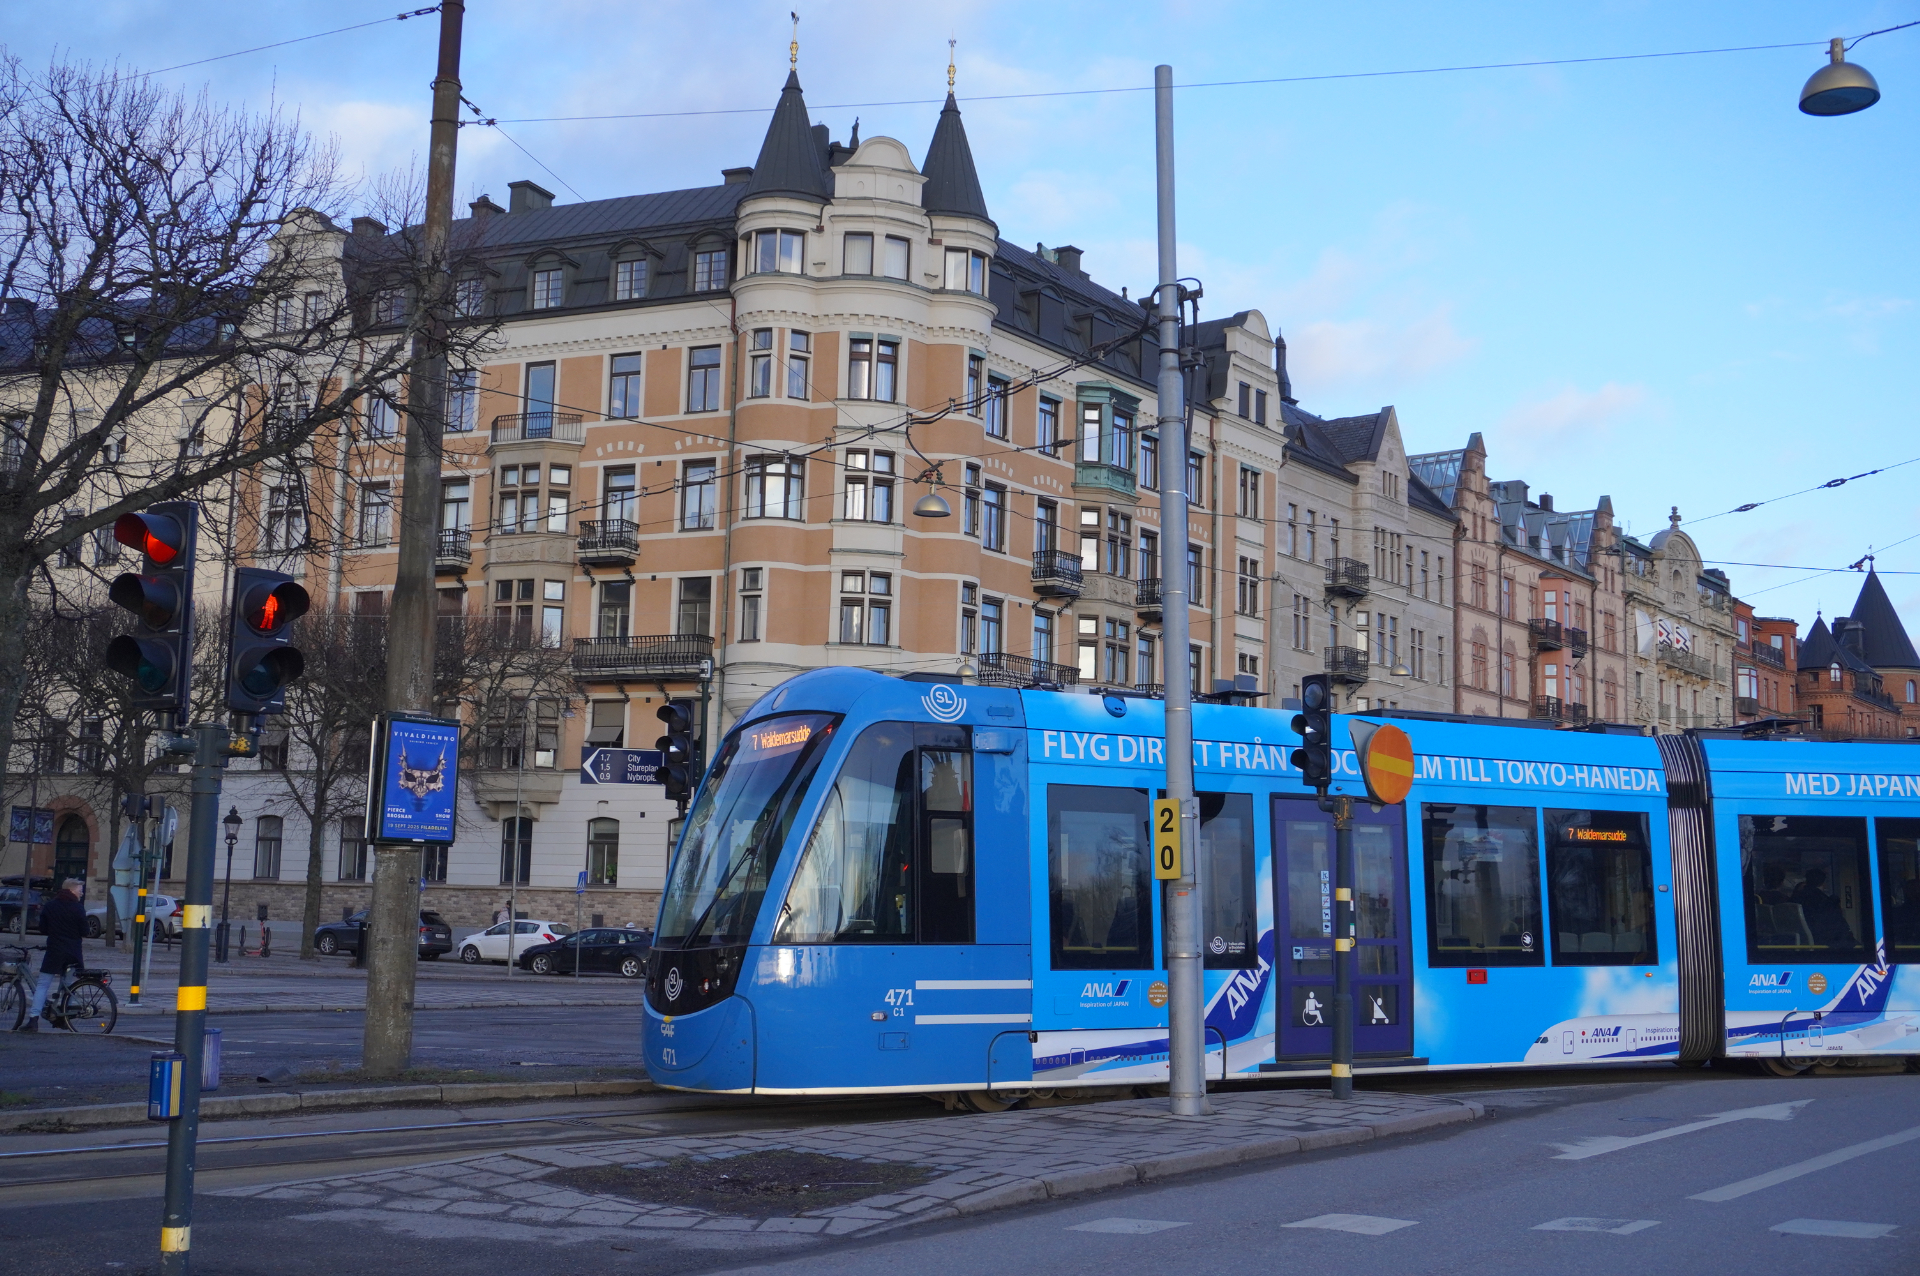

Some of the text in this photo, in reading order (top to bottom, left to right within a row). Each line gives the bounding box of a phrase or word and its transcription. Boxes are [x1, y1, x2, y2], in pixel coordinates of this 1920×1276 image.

[935, 691, 953, 704] SL
[394, 731, 455, 742] VIVALDIANNO
[752, 734, 758, 750] 7
[600, 753, 641, 764] 1,7 City
[1043, 730, 1110, 761] FLYG
[1117, 735, 1213, 767] DIRT
[1219, 736, 1288, 771] FRÅN
[1445, 757, 1492, 782] TILL
[1492, 759, 1661, 792] TOKYO-HANEDA
[600, 763, 611, 771] 1,5
[627, 772, 658, 783] Nybropla
[1785, 772, 1920, 797] MED JAPAN
[1568, 828, 1628, 842] 7 Waldemarsudde
[670, 974, 677, 985] SL
[1748, 974, 1777, 986] ANA
[1080, 982, 1113, 998] ANA
[1226, 954, 1271, 1021] ANA
[884, 988, 914, 1006] 471
[1080, 1001, 1106, 1009] Inspiration
[893, 1007, 905, 1017] C1
[1591, 1027, 1612, 1038] ANA
[1645, 1027, 1673, 1035] Inspiration
[662, 1047, 677, 1066] 471
